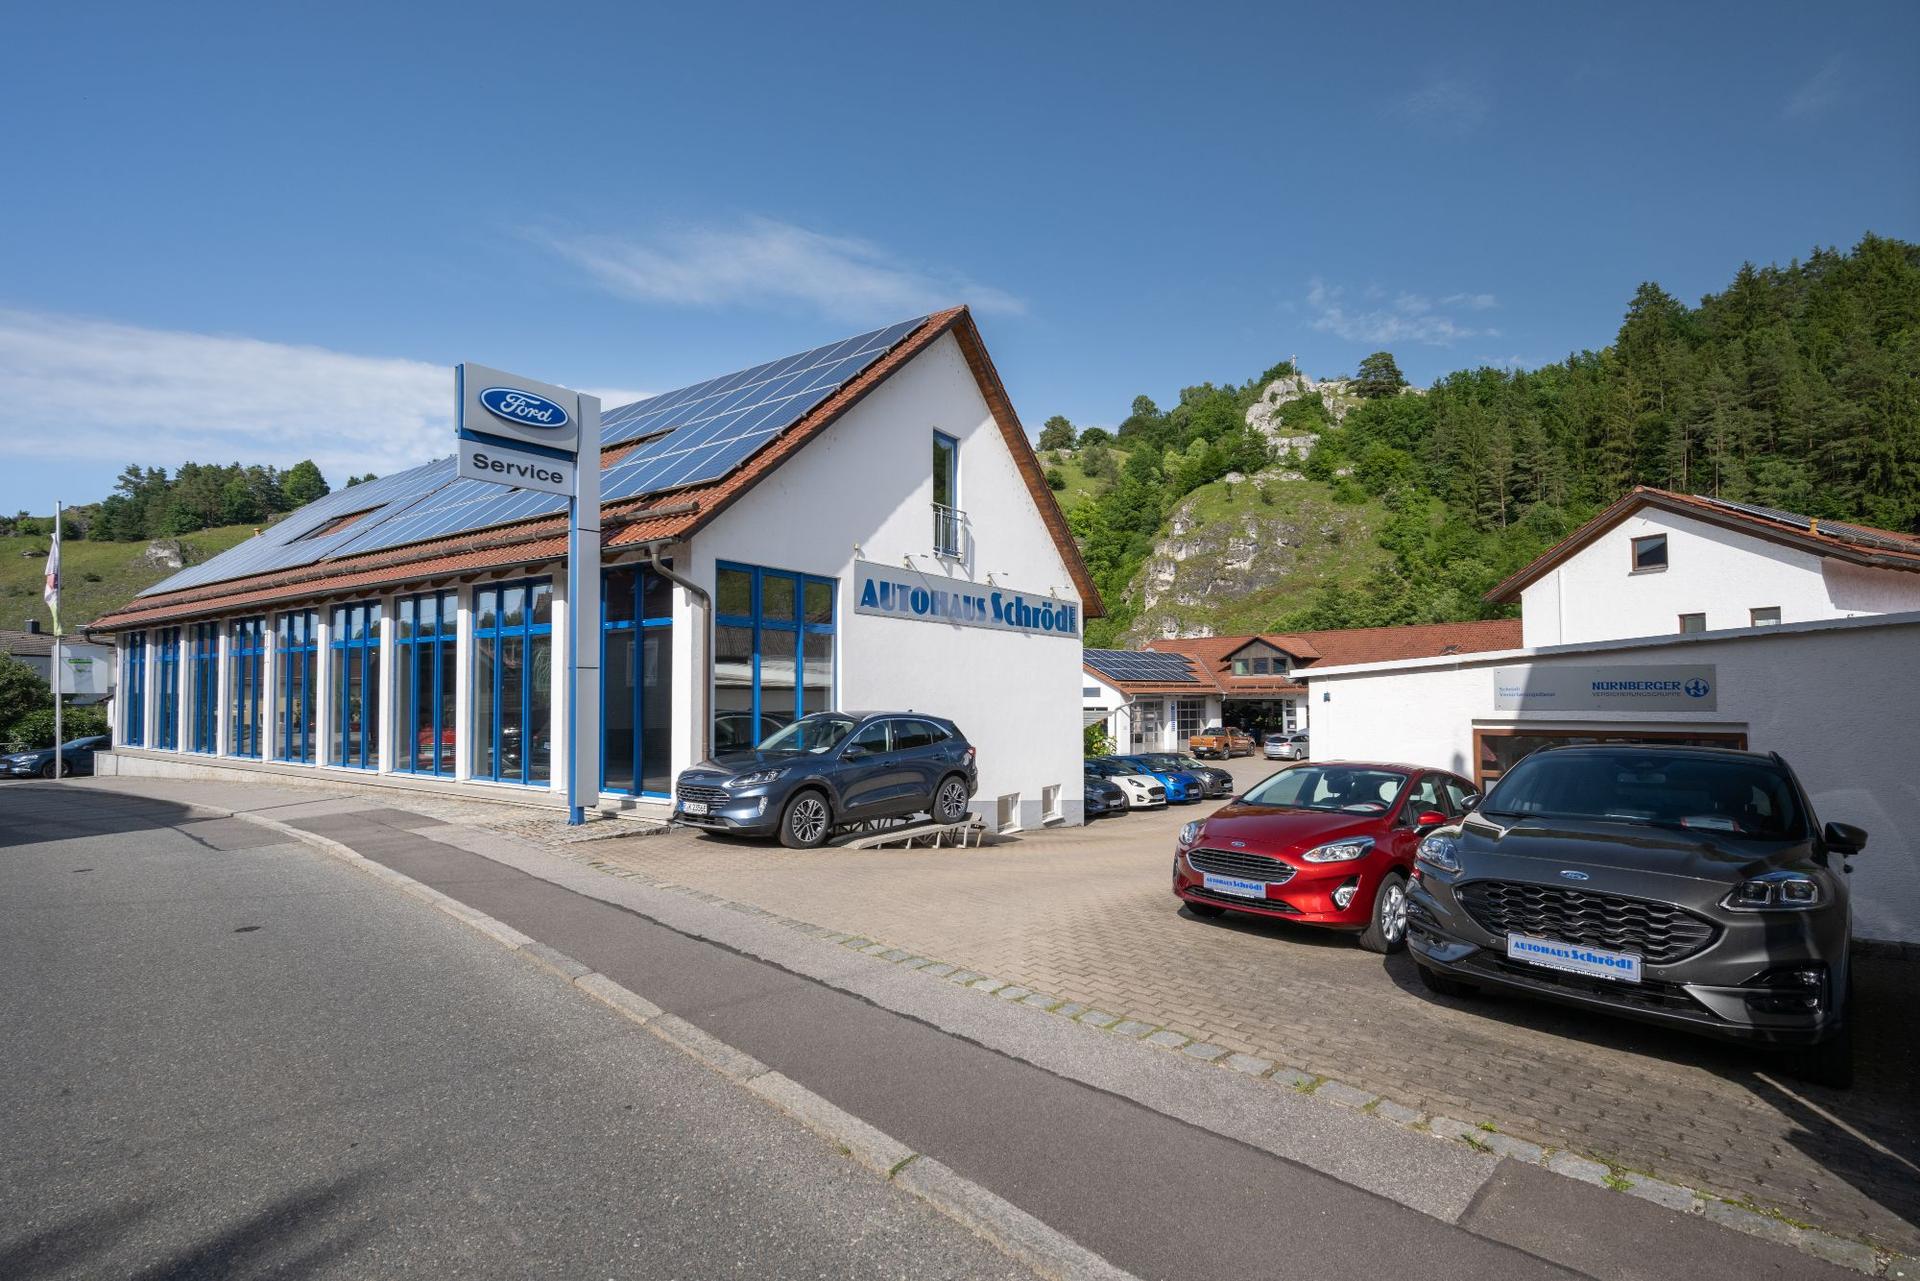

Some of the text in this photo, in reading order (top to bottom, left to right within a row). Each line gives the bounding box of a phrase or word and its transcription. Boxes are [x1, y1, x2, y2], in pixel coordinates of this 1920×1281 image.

[500, 393, 552, 422] Ford
[472, 453, 564, 484] Service
[860, 578, 986, 622] AUTOHAUS
[991, 592, 1074, 633] Schrödl
[1591, 681, 1681, 691] NÜRNBERGER
[1514, 941, 1633, 970] AUTOHAUS Schrödl
